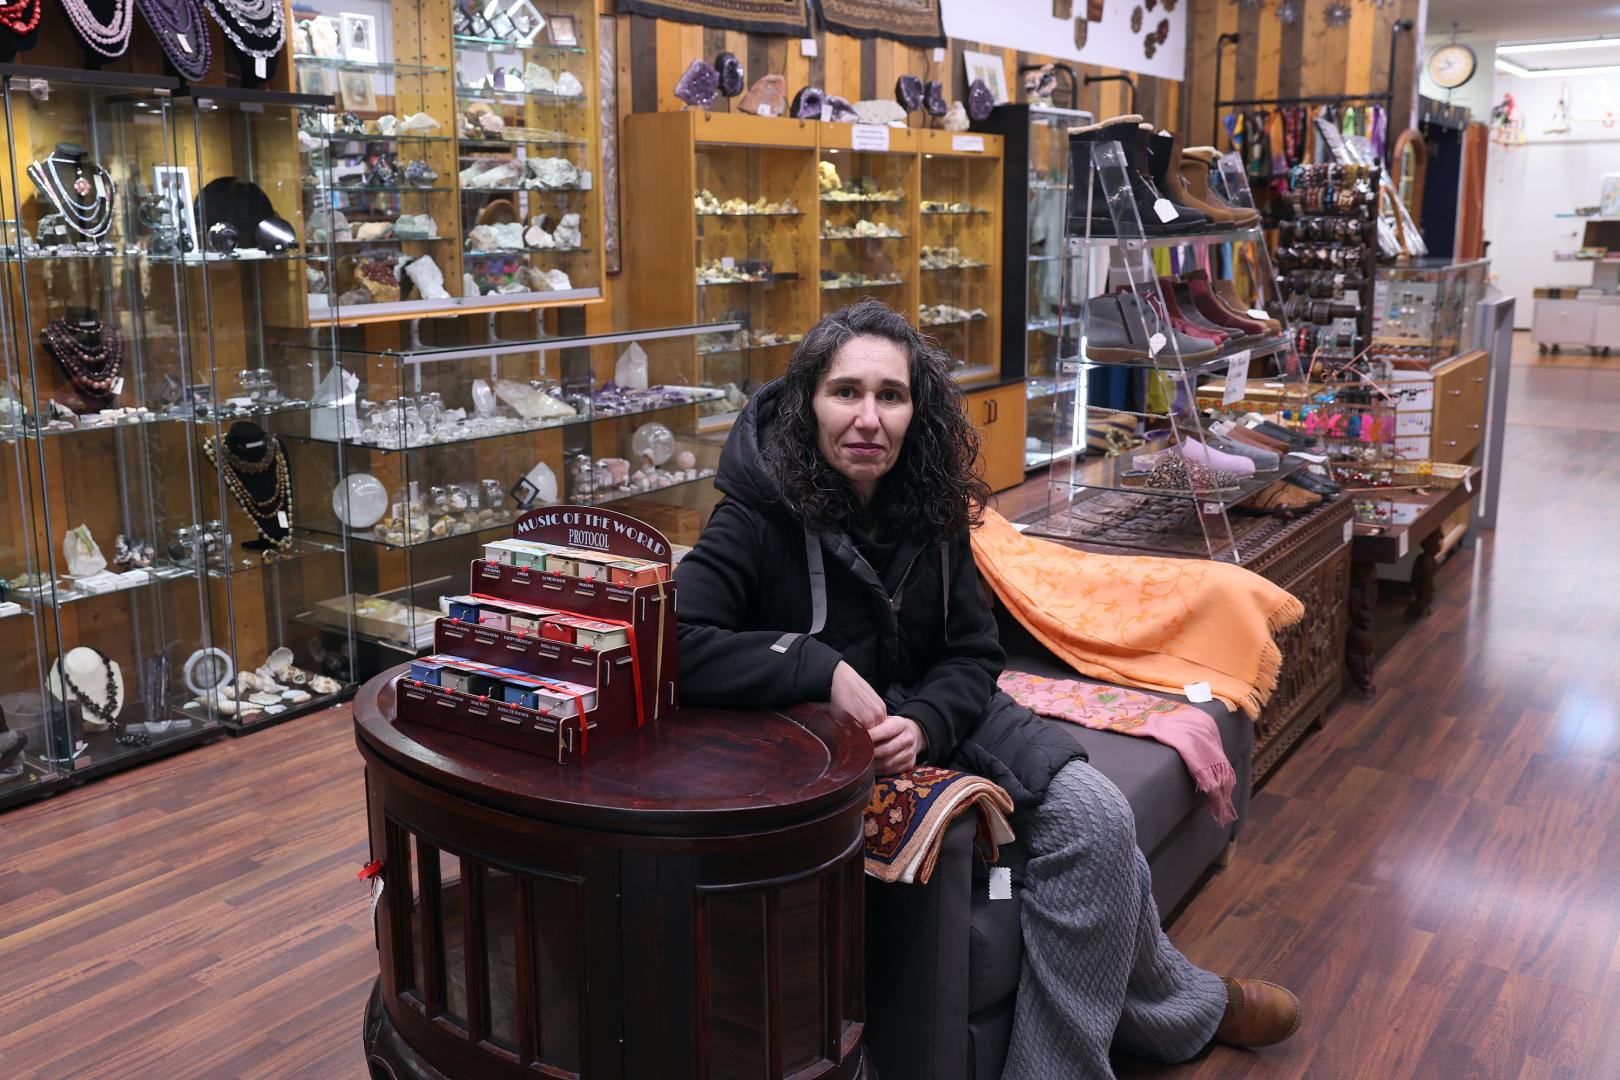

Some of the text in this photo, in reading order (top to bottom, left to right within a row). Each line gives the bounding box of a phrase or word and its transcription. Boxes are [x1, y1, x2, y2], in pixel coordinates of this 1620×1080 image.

[517, 512, 666, 556] MUSIC OF THE WORLD
[568, 528, 609, 548] PROTOCOL
